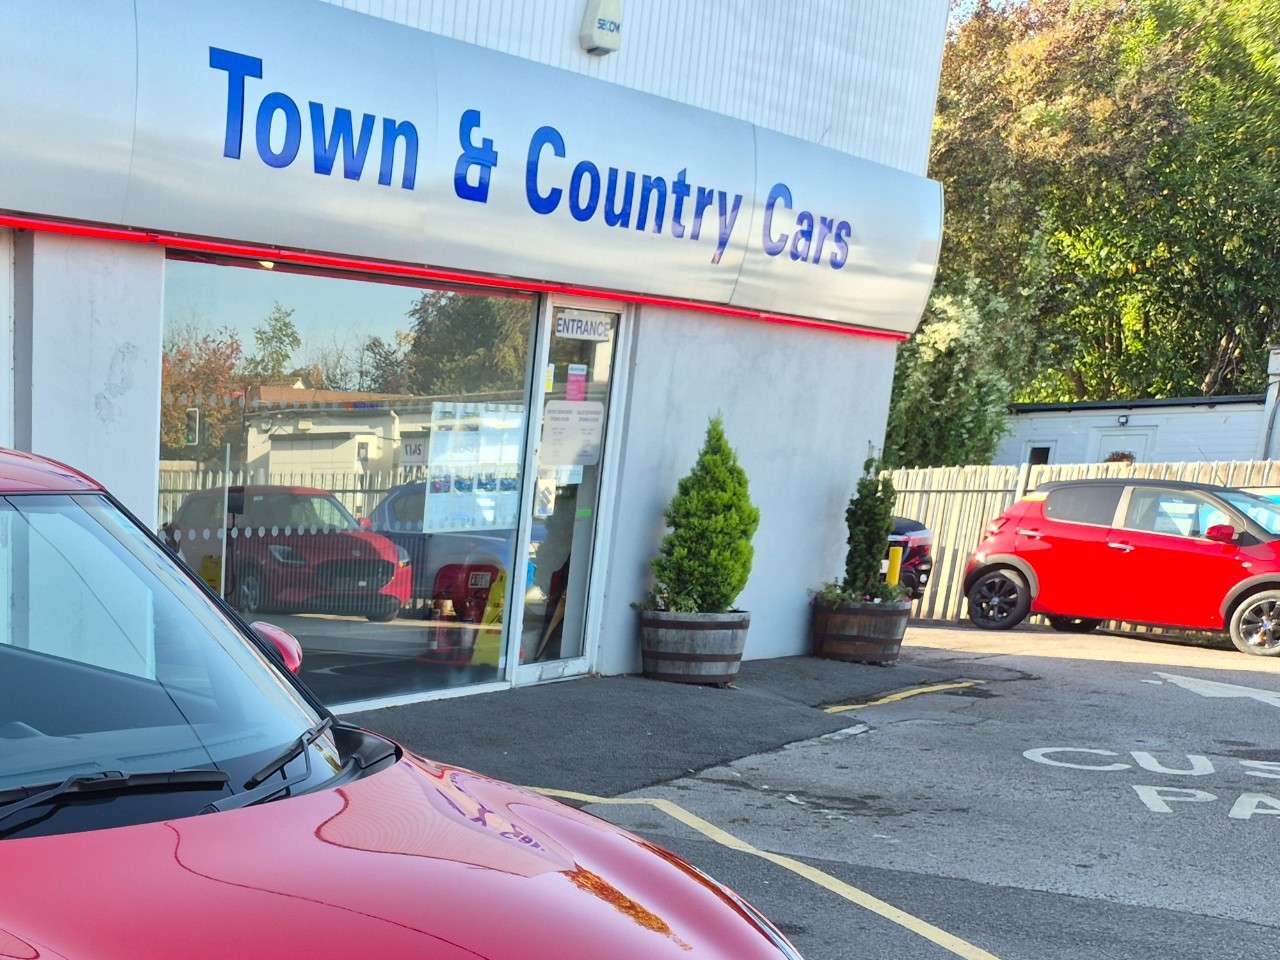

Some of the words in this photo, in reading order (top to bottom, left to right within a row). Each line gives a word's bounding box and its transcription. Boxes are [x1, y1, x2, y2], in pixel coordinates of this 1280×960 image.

[209, 45, 419, 191] Town
[453, 109, 498, 204] &
[525, 125, 743, 265] Country
[761, 183, 852, 270] Cars
[556, 317, 610, 337] ENTRANCE
